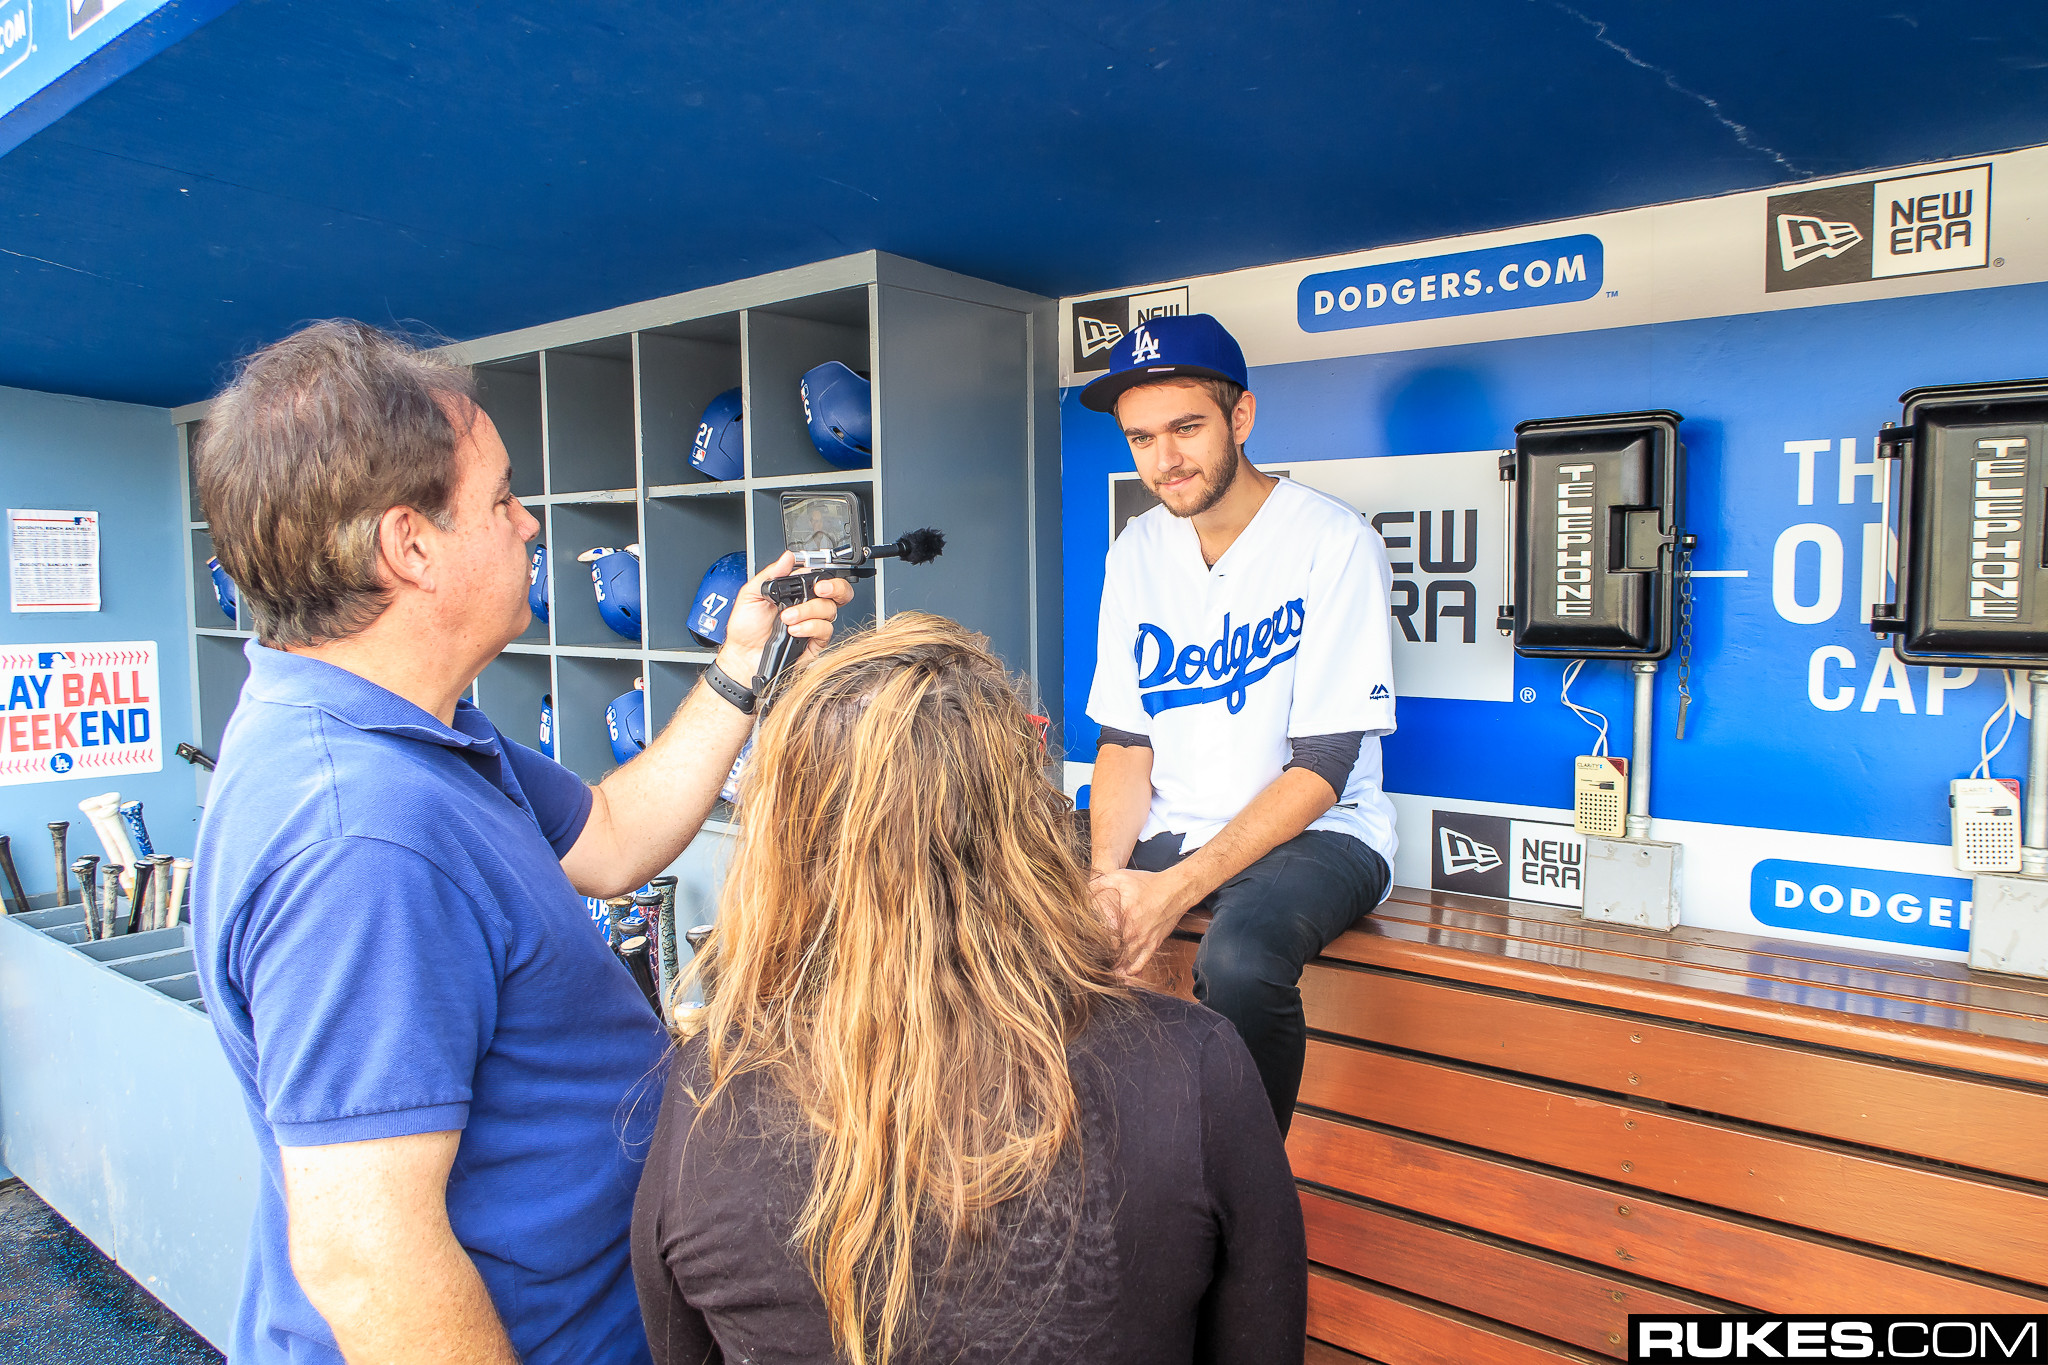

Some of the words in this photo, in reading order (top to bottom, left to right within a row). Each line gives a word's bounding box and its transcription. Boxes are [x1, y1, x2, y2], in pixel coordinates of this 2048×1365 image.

[1891, 189, 1973, 227] NEW
[1890, 219, 1972, 255] ERA
[1313, 254, 1587, 316] DODGERS.COM
[1131, 325, 1161, 365] LA
[695, 422, 714, 449] 21
[1362, 509, 1478, 574] EW
[1556, 464, 1595, 616] TELEPHONE
[1969, 438, 2028, 618] TELEPHONE
[702, 592, 729, 617] 47
[1391, 579, 1478, 644] RA
[1134, 597, 1305, 715] Dodgers
[0, 674, 53, 711] AY
[62, 670, 150, 708] BALL
[1808, 645, 1979, 716] CAP
[0, 708, 150, 752] EEKEND
[1522, 838, 1581, 867] NEW
[1521, 862, 1581, 891] ERA
